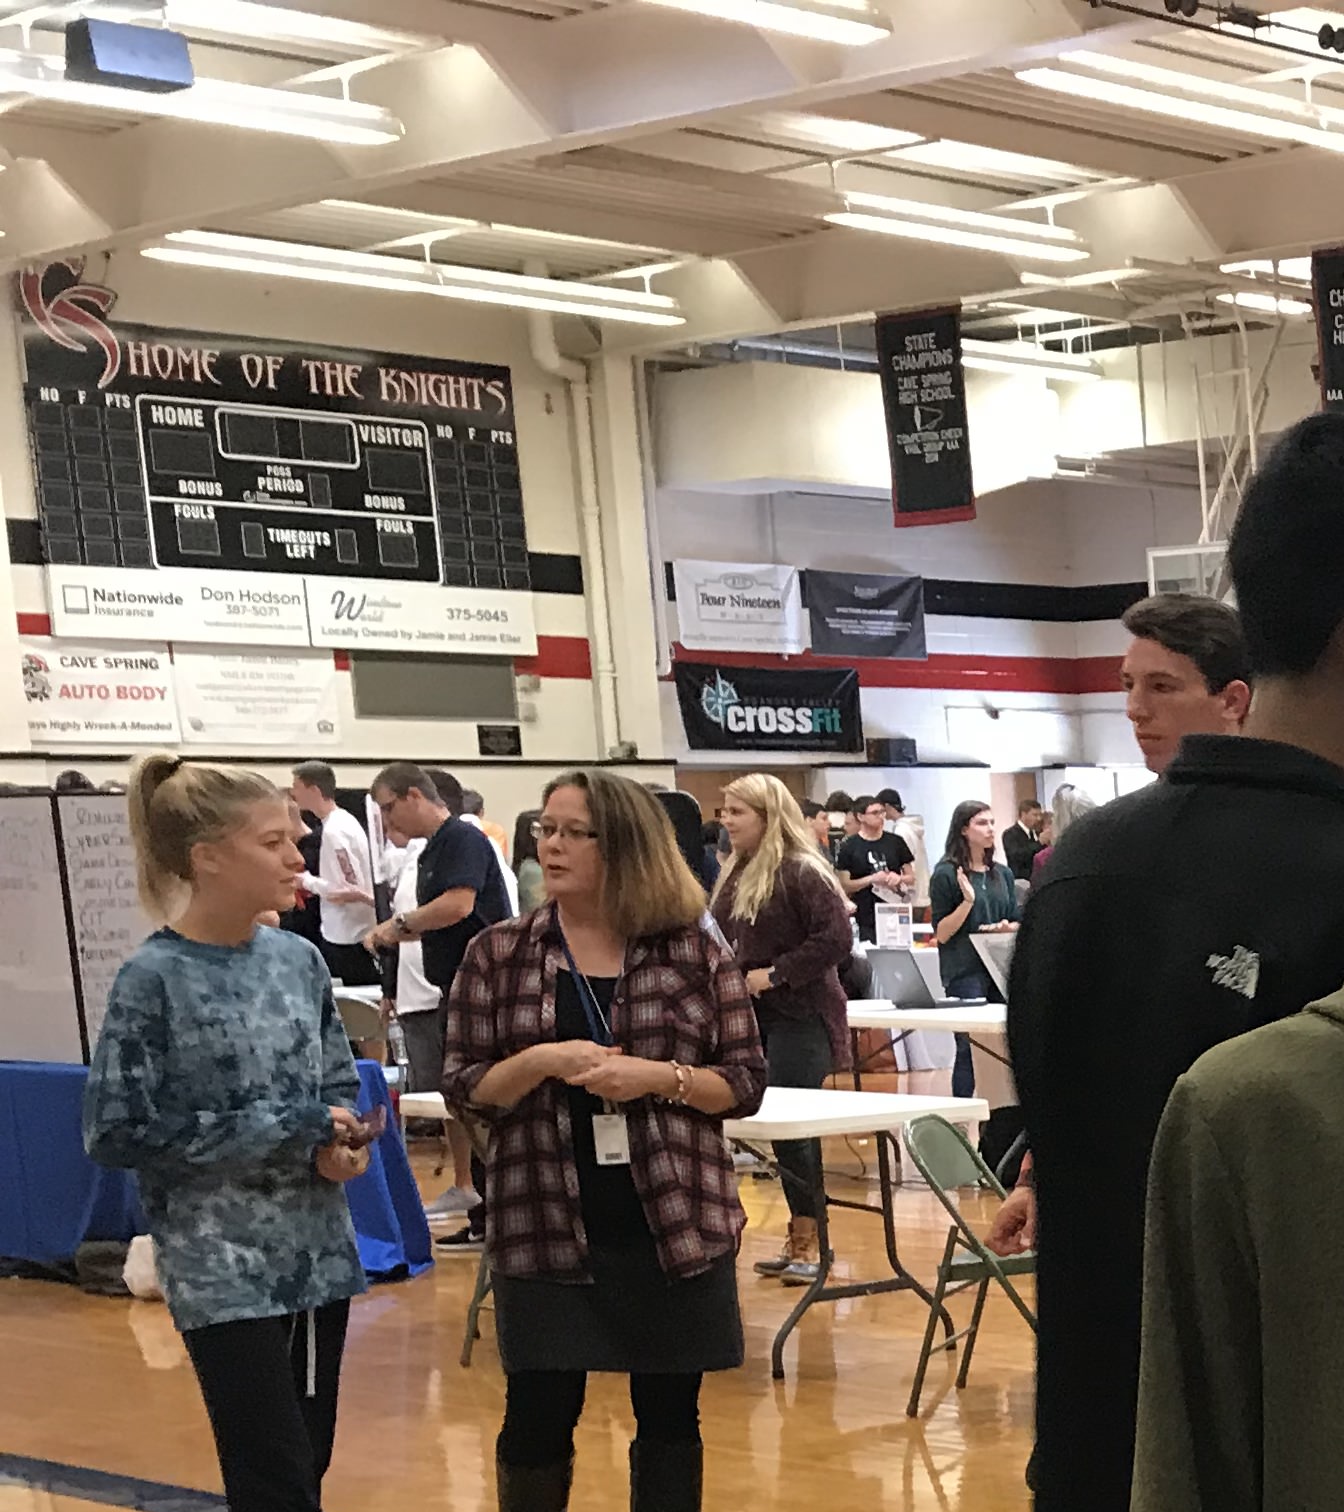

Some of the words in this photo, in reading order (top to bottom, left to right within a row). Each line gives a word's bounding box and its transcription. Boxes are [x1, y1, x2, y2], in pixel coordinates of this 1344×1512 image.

[128, 341, 222, 385] HOME
[240, 353, 284, 390] OF
[302, 359, 364, 399] THE
[378, 367, 506, 415] KNIGHTS
[151, 405, 204, 427] HOME
[359, 424, 424, 448] VISITOR
[179, 480, 223, 496] BONUS
[258, 477, 304, 492] PERIOD
[364, 495, 405, 511] BONUS
[175, 504, 215, 519] FOULS
[376, 519, 414, 533] FOULS
[267, 528, 330, 545] TIMEOUTS
[286, 545, 316, 559] LEFT
[93, 588, 183, 605] Nationwide
[201, 587, 234, 601] Don
[239, 588, 301, 605] Hodson
[730, 595, 782, 610] Nineteen
[94, 606, 154, 617] Insurance
[446, 608, 508, 623] 375-5045
[321, 626, 358, 638] Locally
[400, 630, 411, 640] by
[448, 632, 466, 641] and
[60, 656, 98, 668] CAVE
[104, 658, 160, 670] SPRING
[59, 684, 110, 700] AUTO
[116, 686, 167, 700] BODY
